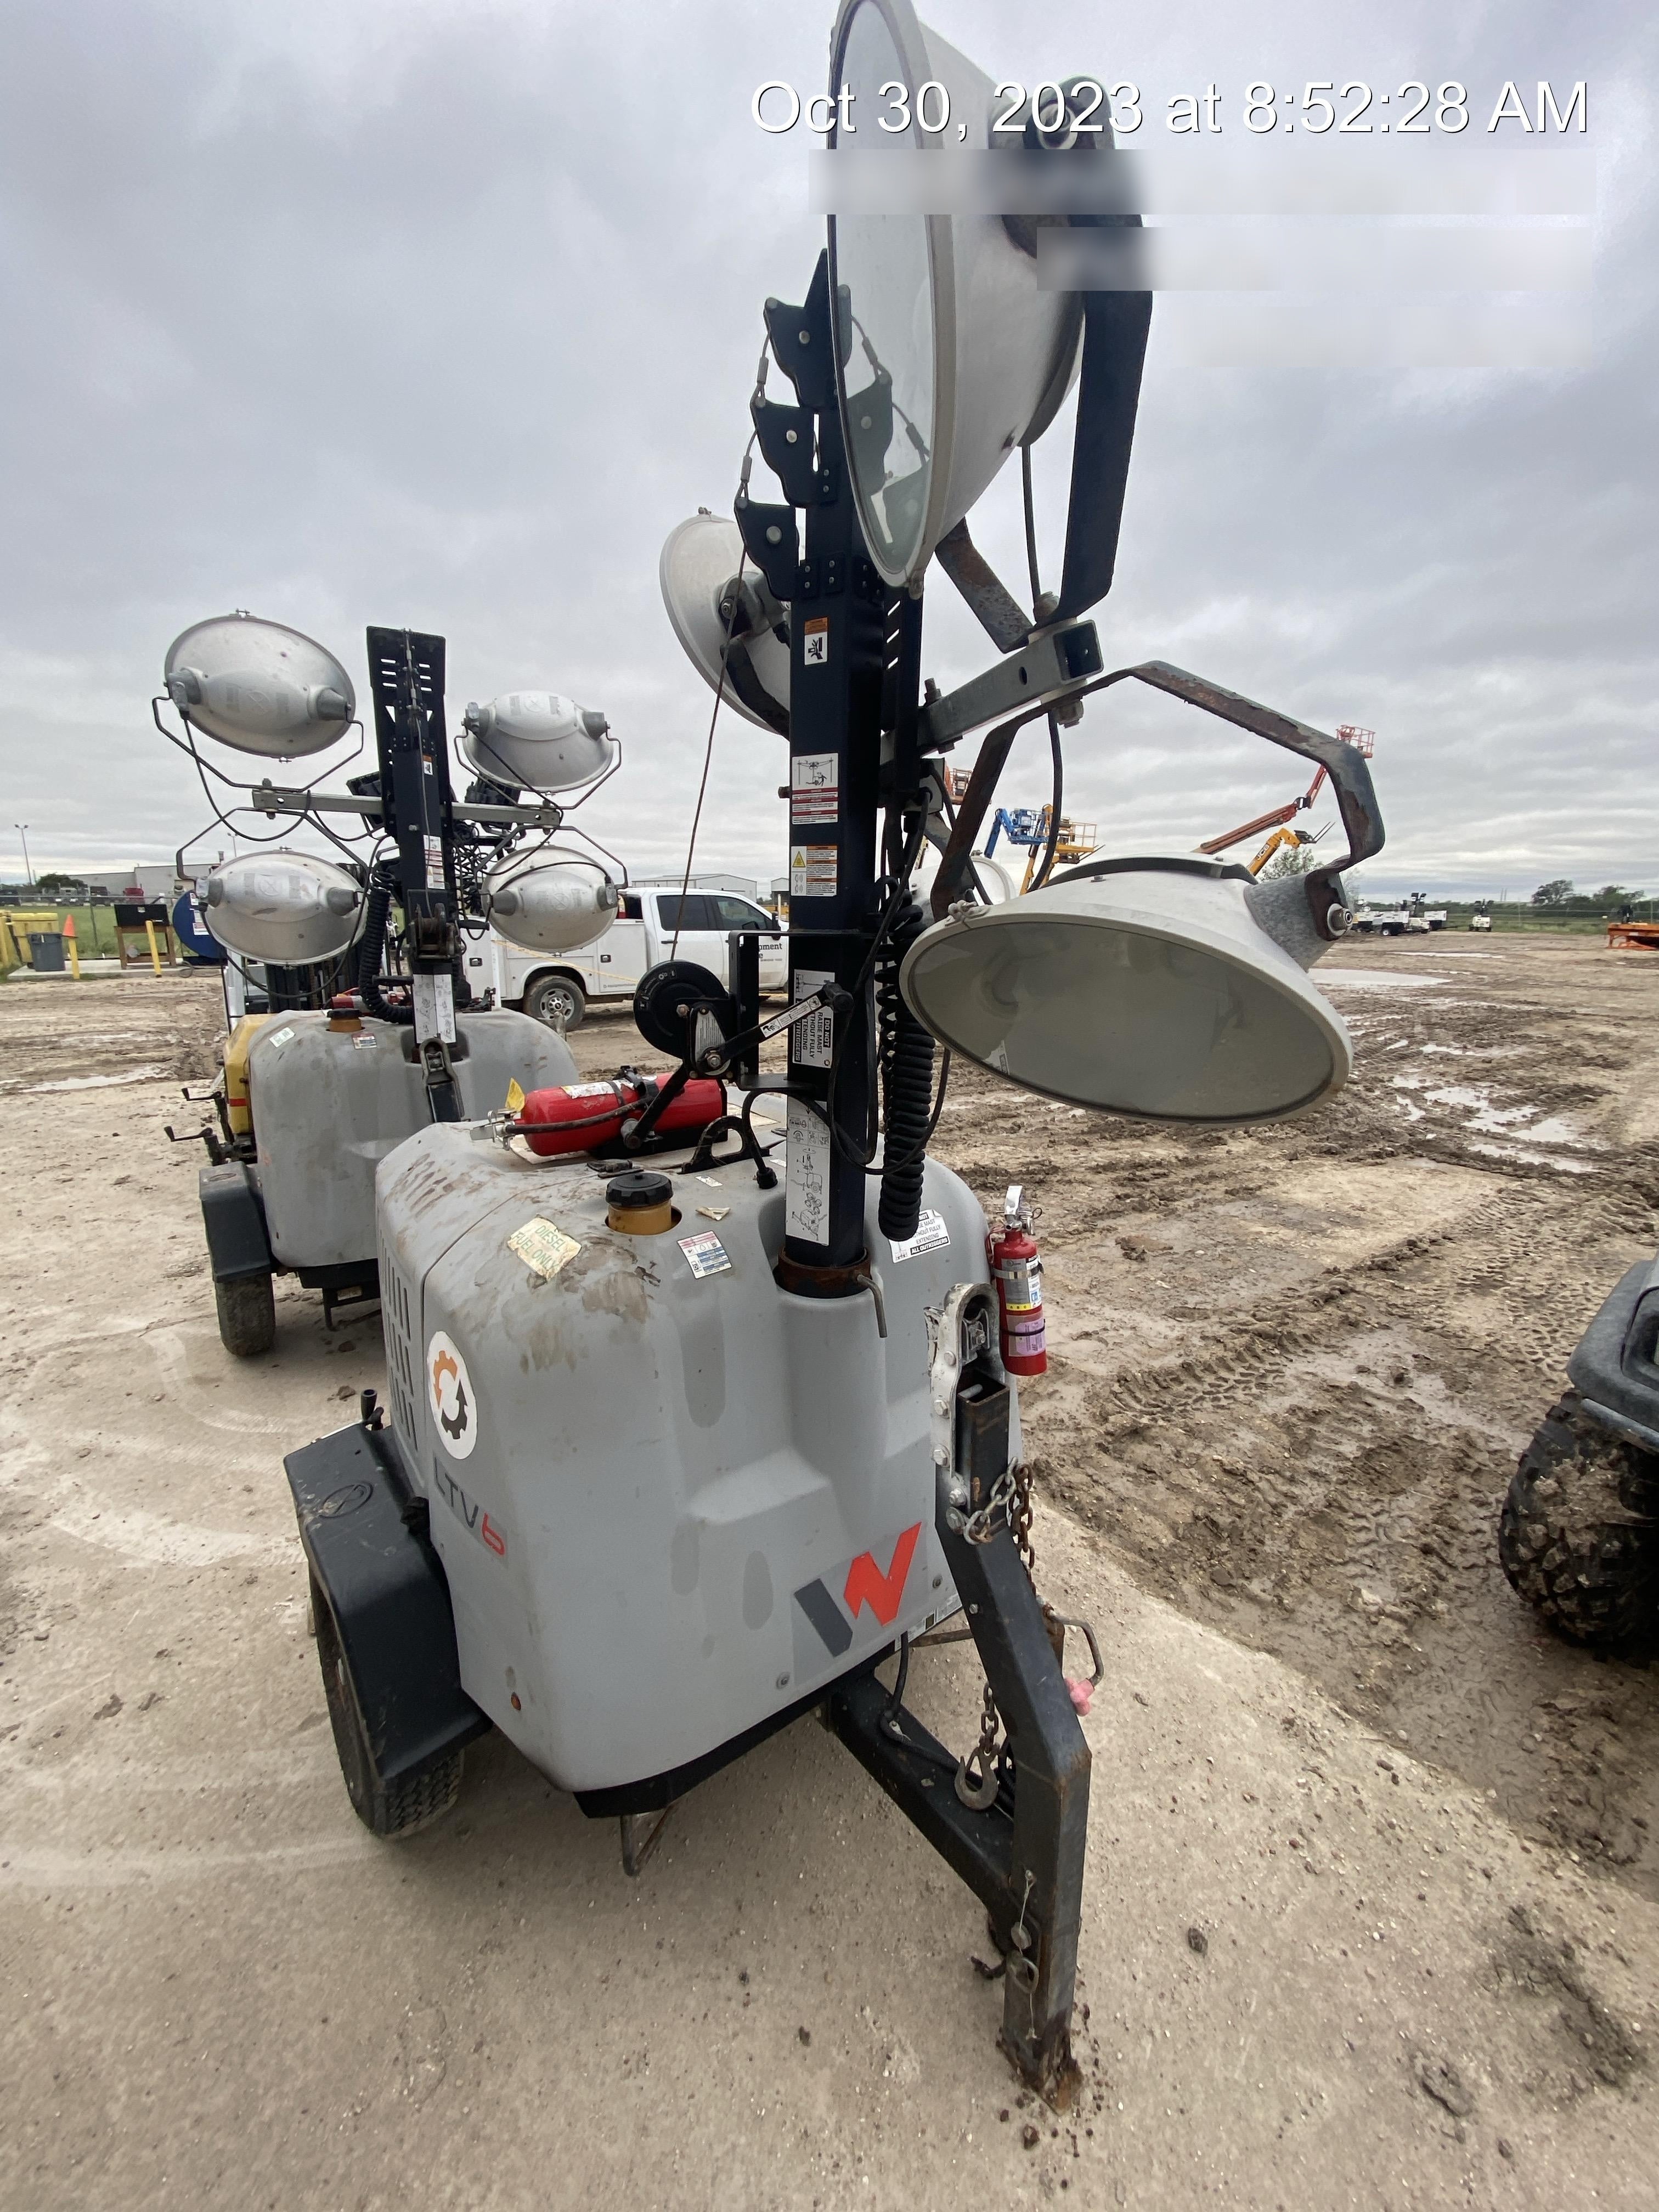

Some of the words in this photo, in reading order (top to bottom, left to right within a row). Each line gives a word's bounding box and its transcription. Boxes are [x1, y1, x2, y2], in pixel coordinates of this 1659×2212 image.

[1257, 844, 1270, 861] JCB
[825, 1020, 830, 1029] DO
[929, 1224, 941, 1233] FULLY
[535, 1225, 566, 1252] DIESEL
[916, 1233, 939, 1244] EXTENDING
[919, 1238, 948, 1251] OUTRIGGERS
[511, 1231, 535, 1252] FUEL
[531, 1249, 560, 1269] ONLY
[435, 1457, 505, 1555] LTV6
